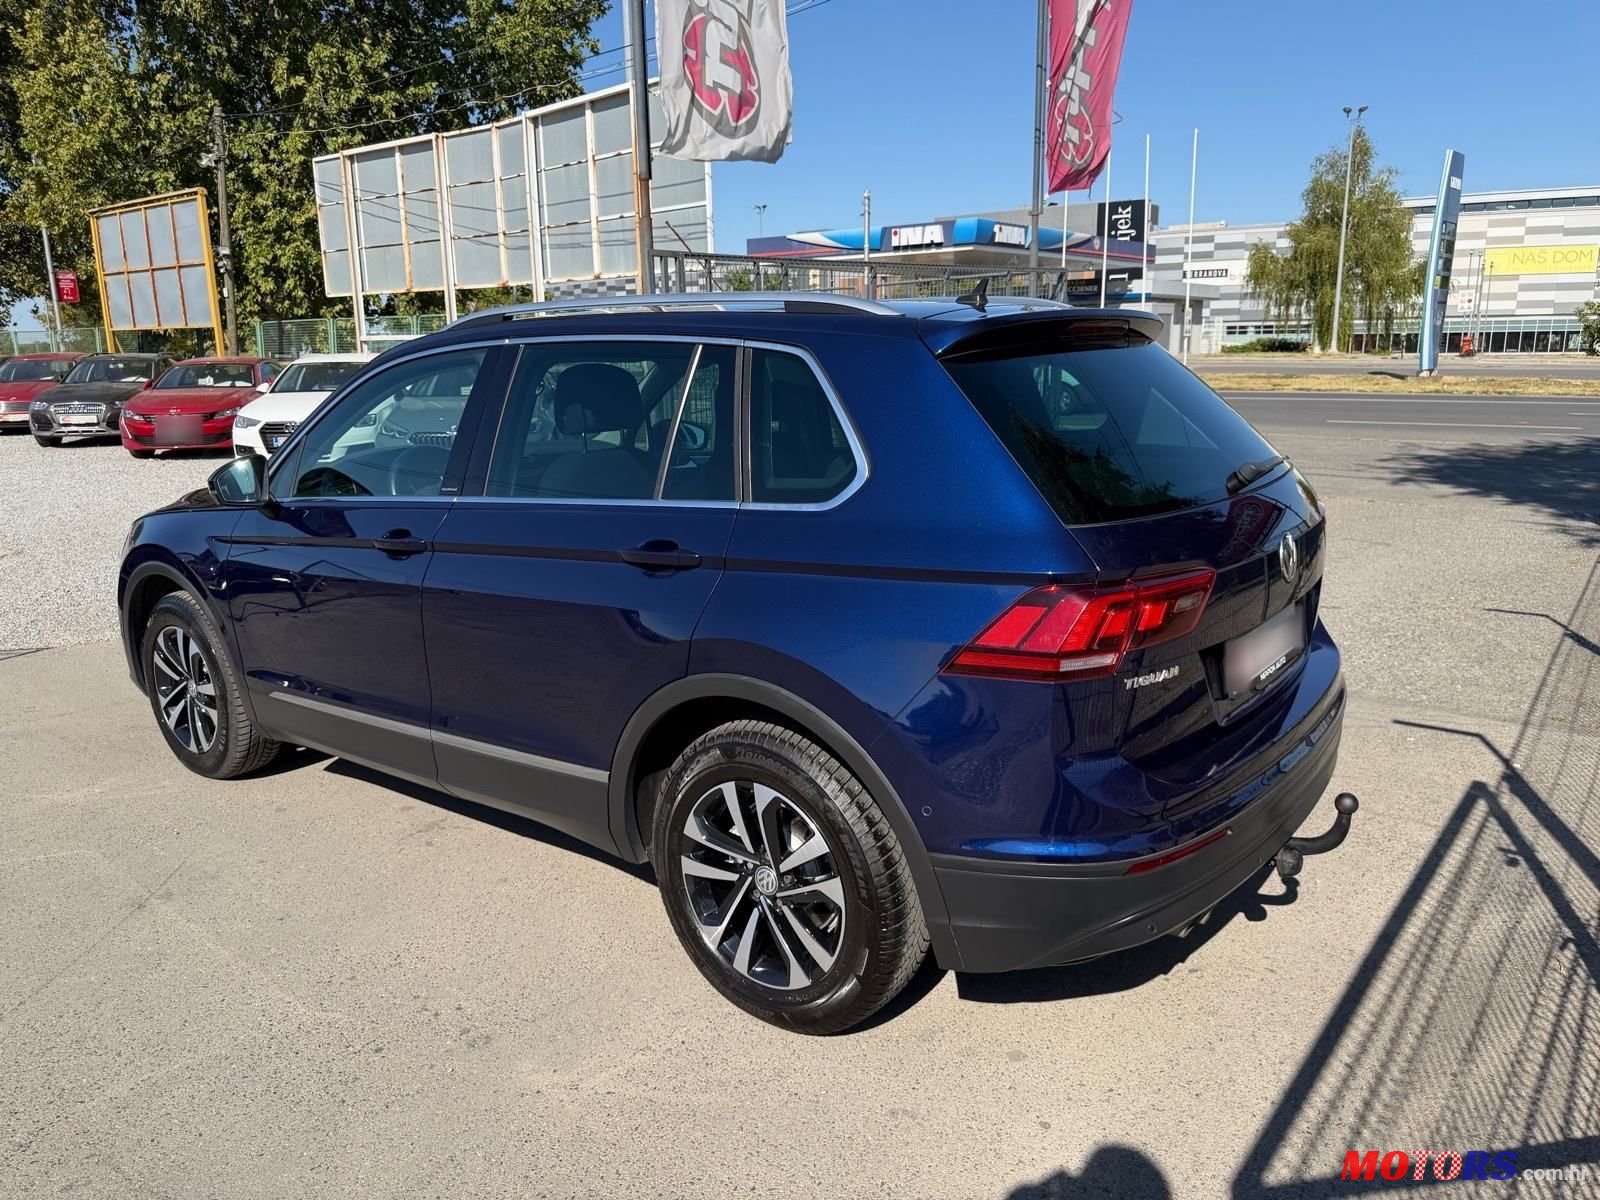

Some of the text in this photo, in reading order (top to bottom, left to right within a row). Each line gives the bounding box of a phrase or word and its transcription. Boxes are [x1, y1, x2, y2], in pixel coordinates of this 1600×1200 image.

[1512, 249, 1593, 264] NAŠ DOM
[1124, 665, 1179, 690] TIGUAN
